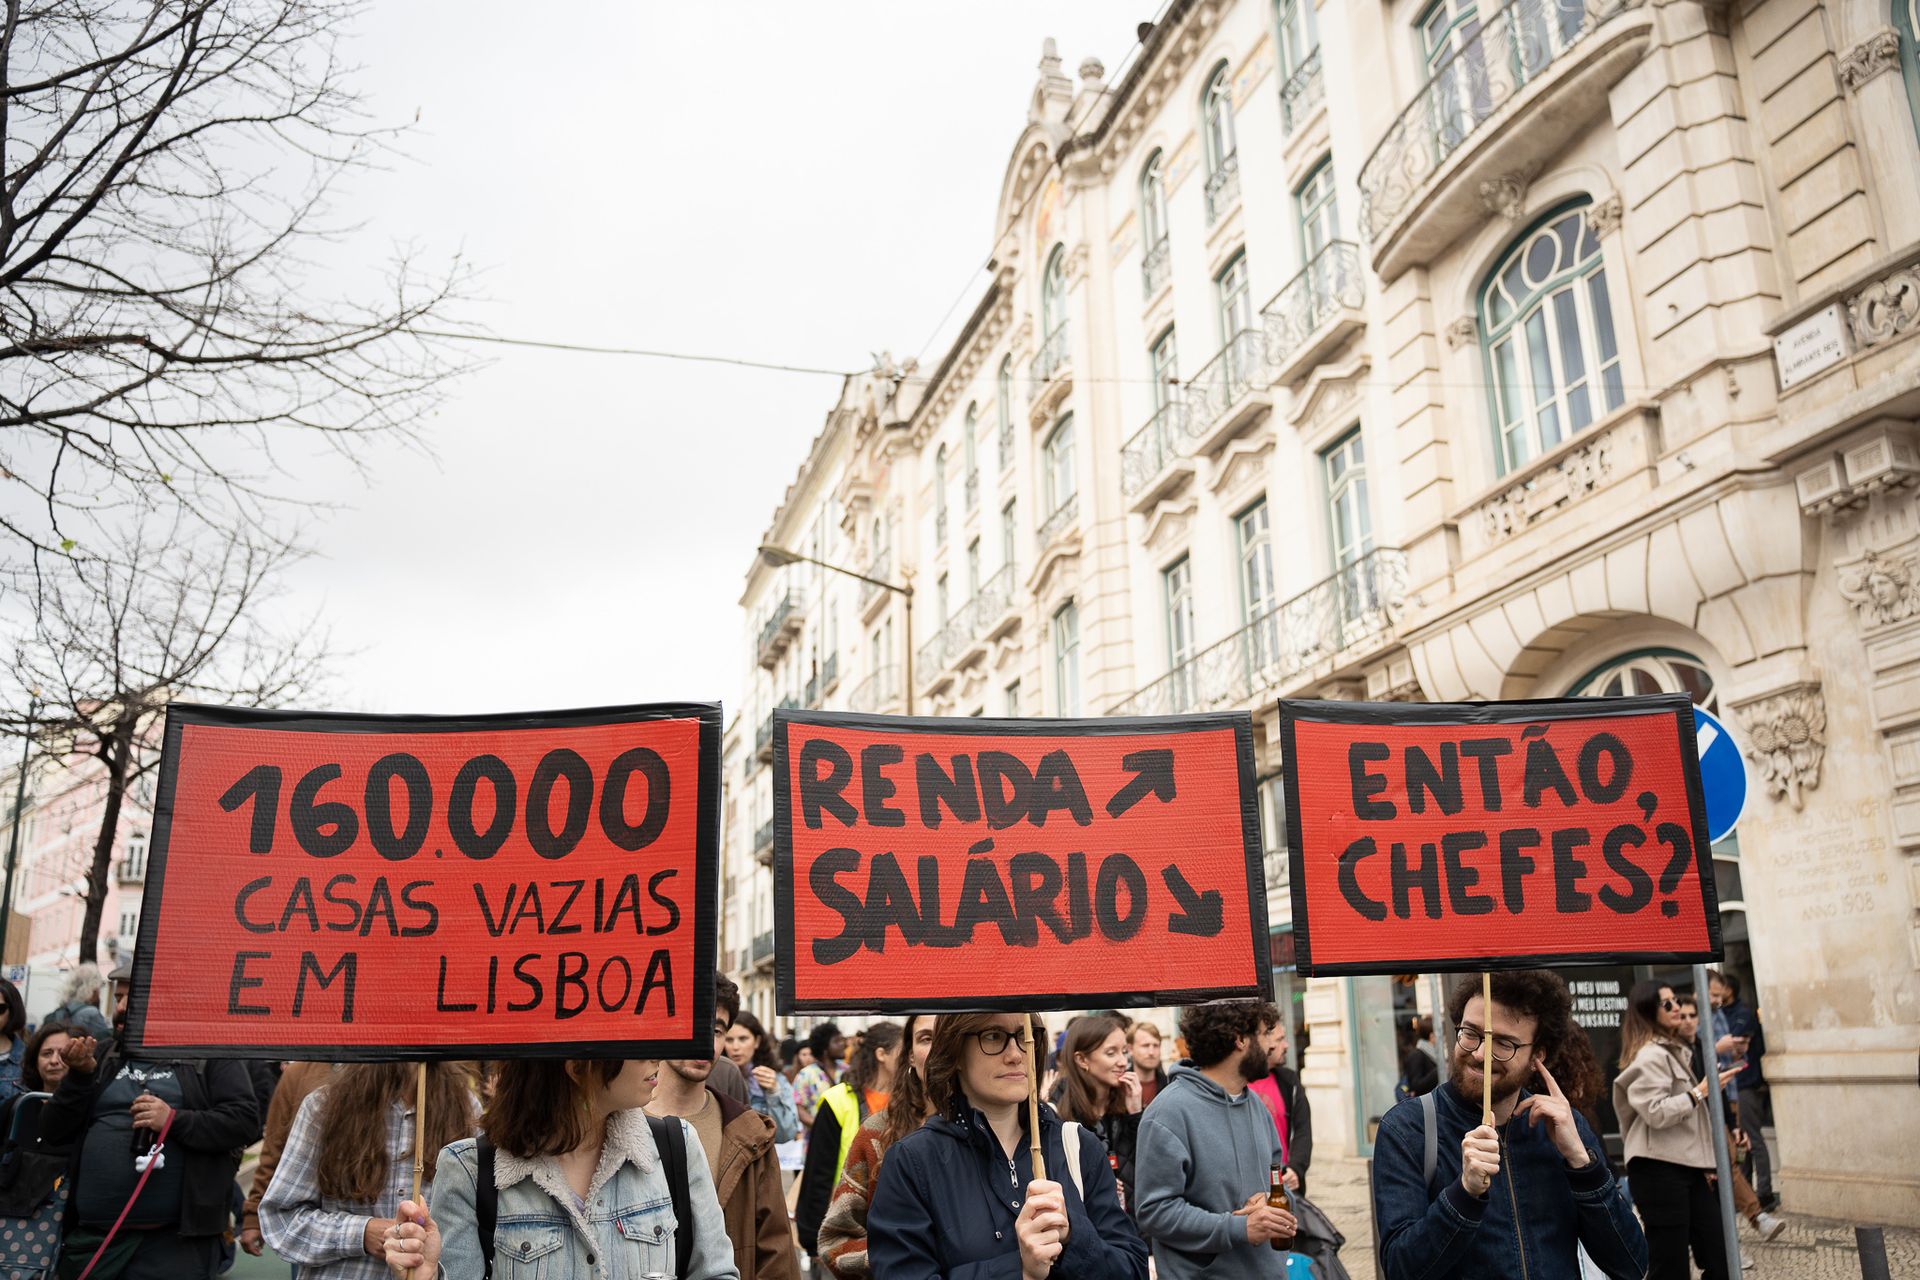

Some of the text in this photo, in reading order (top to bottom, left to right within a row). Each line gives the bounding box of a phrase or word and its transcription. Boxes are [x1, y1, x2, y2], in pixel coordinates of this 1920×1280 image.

[218, 747, 671, 861] 160.000
[799, 738, 1094, 829] RENDA
[1348, 724, 1658, 824] ENTÃO,
[234, 868, 680, 938] CASAS VAZIAS
[809, 837, 1148, 965] SALÁRIO
[1337, 822, 1692, 922] CHEFES?
[227, 949, 676, 1023] EM LISBOA
[1569, 981, 1619, 995] O MEU VINHO
[1578, 997, 1595, 1011] MEU
[1596, 997, 1628, 1011] DESTINO
